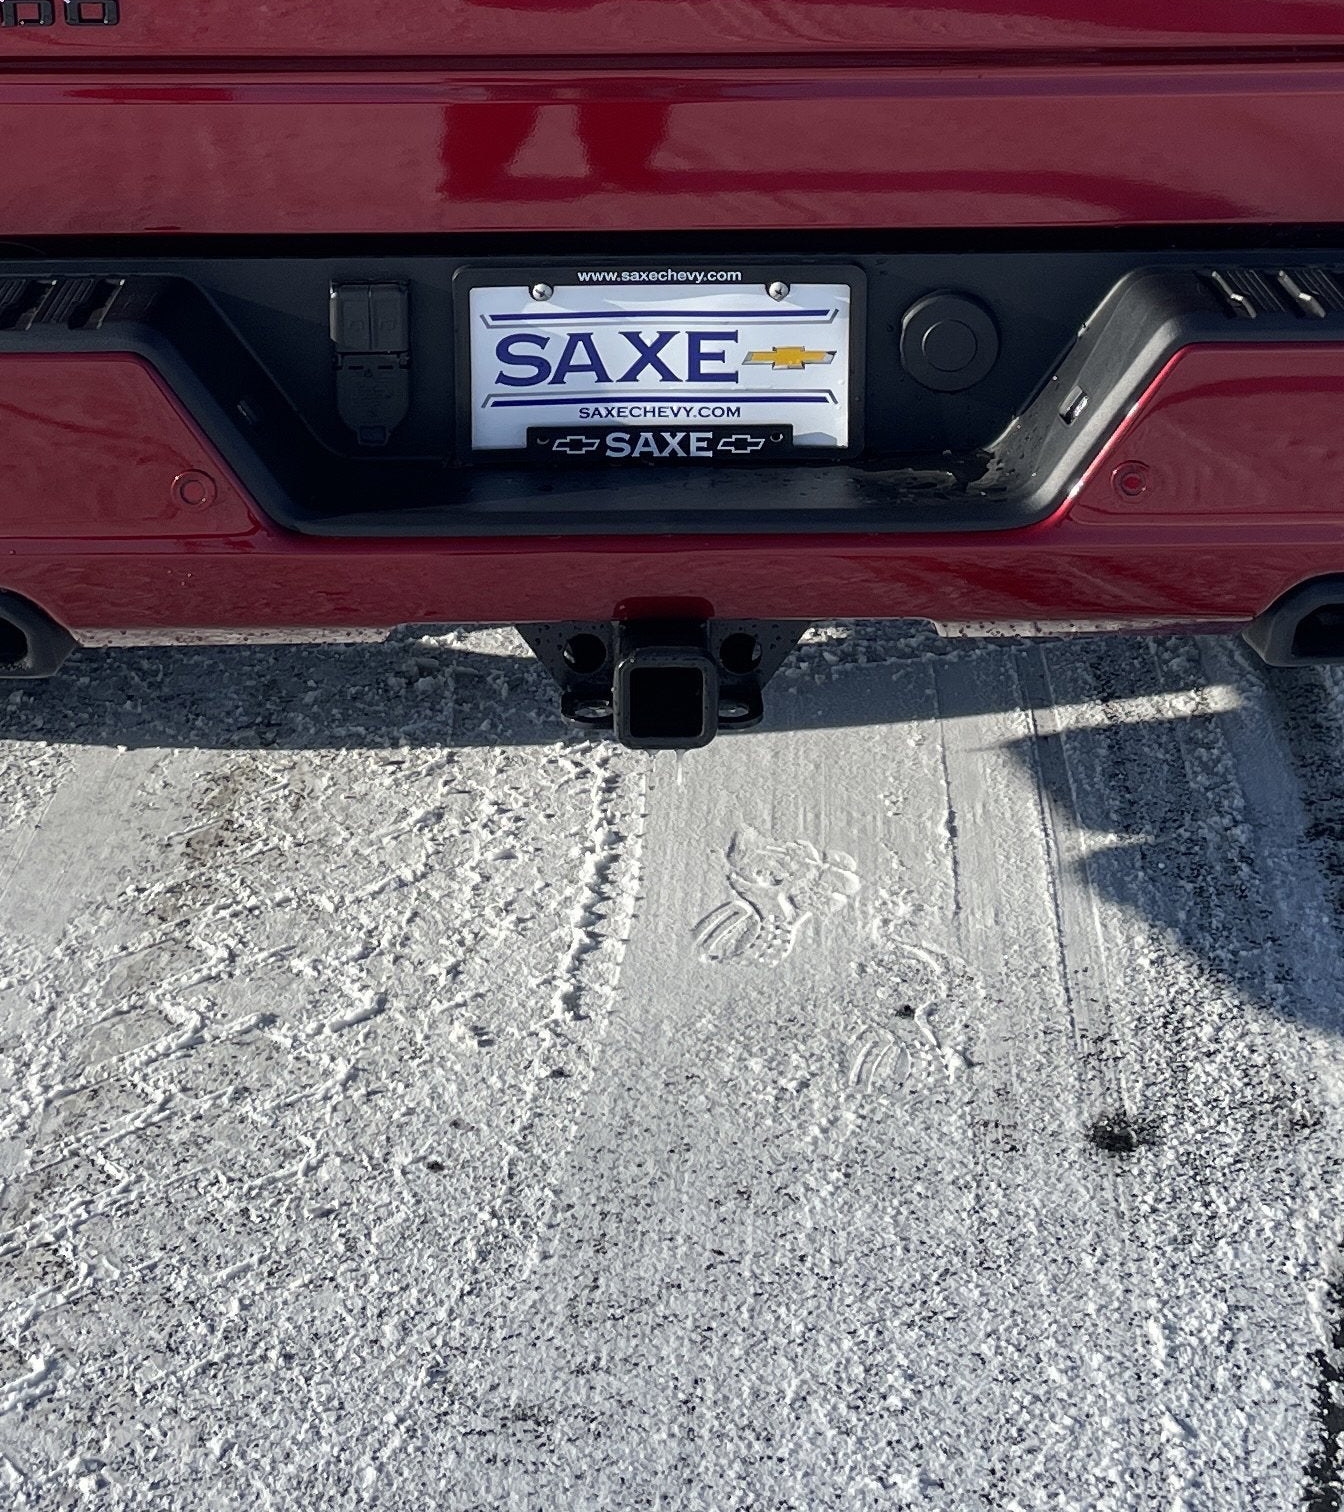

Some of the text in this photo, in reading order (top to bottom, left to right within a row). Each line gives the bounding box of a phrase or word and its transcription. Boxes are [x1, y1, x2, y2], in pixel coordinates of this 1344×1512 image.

[577, 268, 742, 284] www.saxechevy.com
[494, 329, 740, 387] SAXE
[579, 406, 741, 419] SAXECHEVY.COM
[605, 431, 713, 458] SAXE
